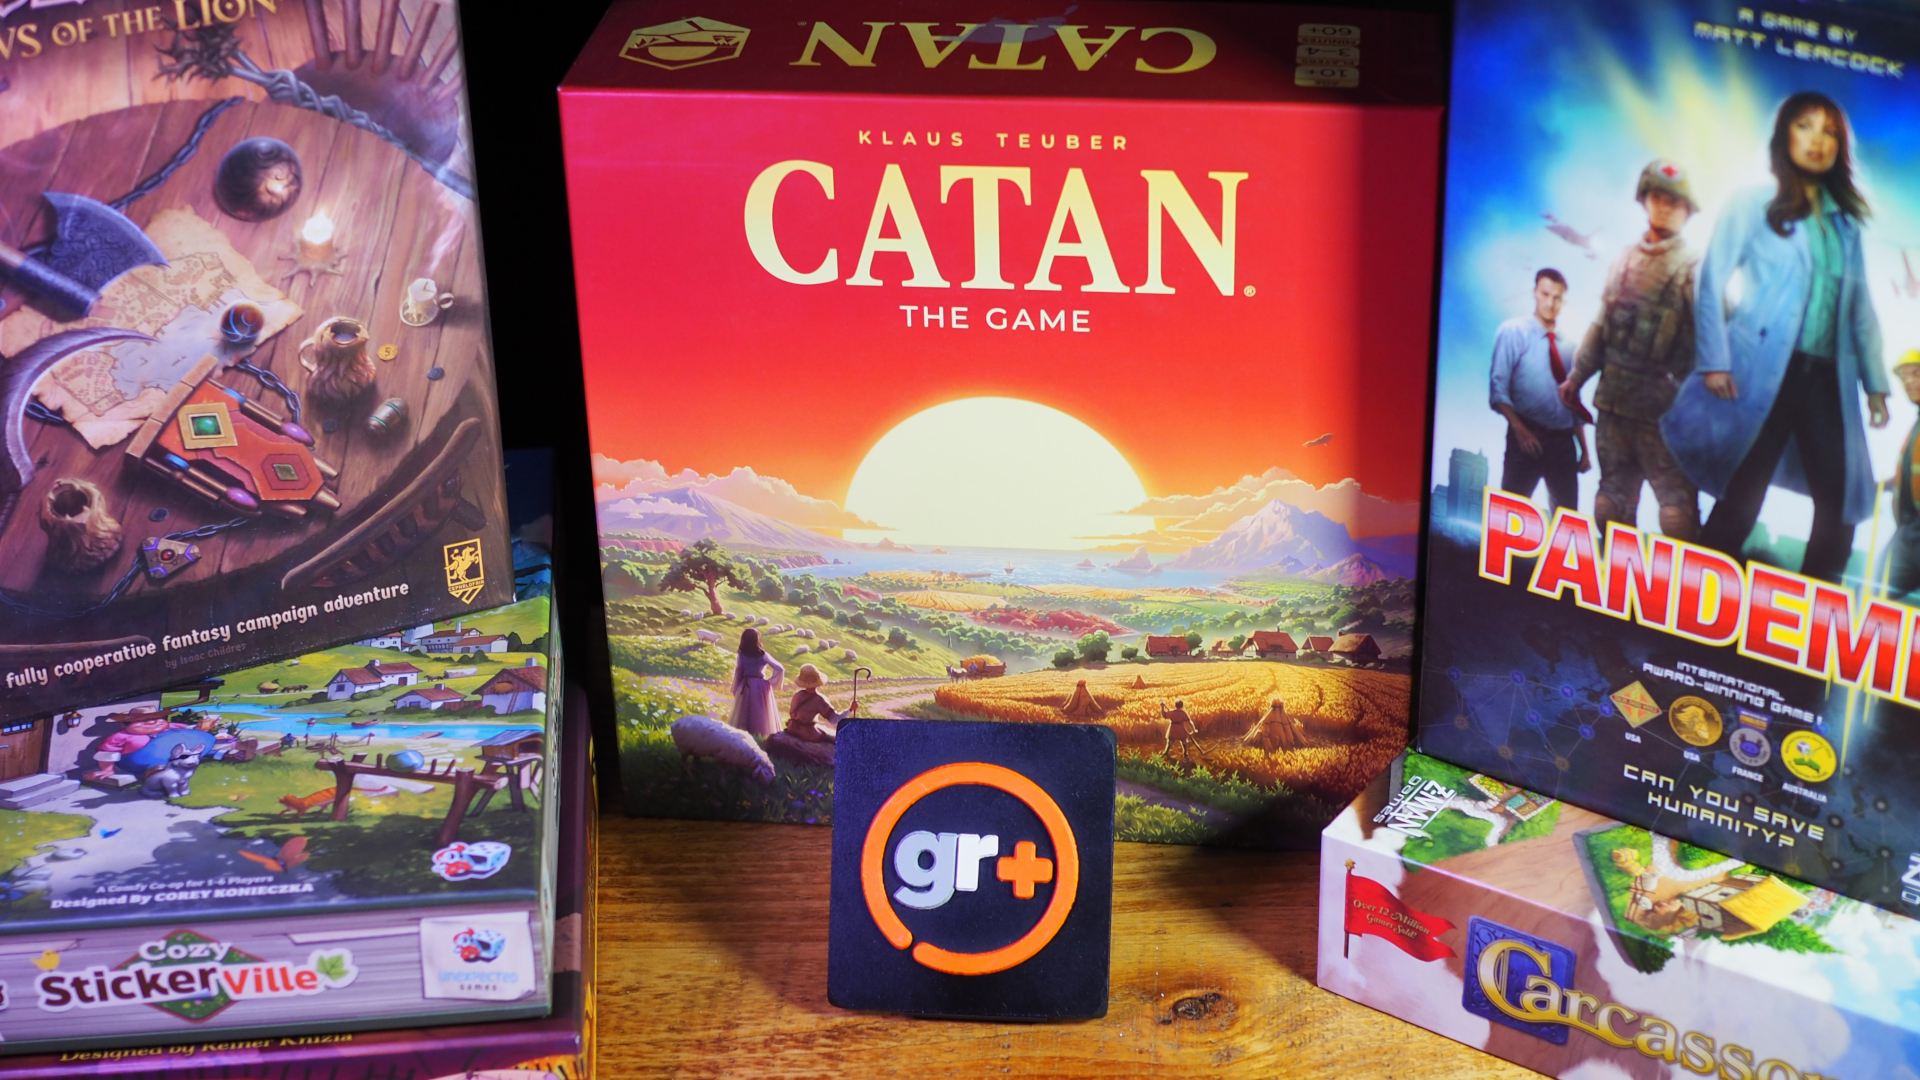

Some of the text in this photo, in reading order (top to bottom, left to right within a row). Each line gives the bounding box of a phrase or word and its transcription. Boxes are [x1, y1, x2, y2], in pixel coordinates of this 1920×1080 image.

[51, 18, 94, 46] OF
[103, 6, 164, 38] THE
[1307, 26, 1352, 36] 60+
[1738, 7, 1858, 45] A GAME BY
[1694, 21, 1905, 80] MATT LEACOCK
[858, 129, 1128, 151] KLAUS TEUBER
[899, 305, 1092, 333] THE GAME
[6, 583, 409, 689] fully cooperative fantasy campaign adventure
[165, 643, 247, 669] by Isaac Childres
[1643, 662, 1764, 709] AWARD-WINNING
[1677, 661, 1785, 702] INTERNATIONAL
[1625, 731, 1641, 744] USA
[1683, 749, 1700, 762] USA
[1731, 765, 1764, 783] FRANCE
[1623, 763, 1825, 841] CAN YOU SAVE
[1782, 781, 1828, 804] AUSTRALIA
[1647, 792, 1795, 848] HUMANITY?
[50, 882, 315, 909] Designed By COREY KONIECZKA
[96, 875, 274, 893] A Comfy Co-op for 1-6 Players
[1353, 899, 1430, 935] Over 12 Million
[1366, 913, 1418, 939] Games Sold!
[139, 940, 233, 962] Cozy
[1477, 939, 1842, 1080] Carcasso
